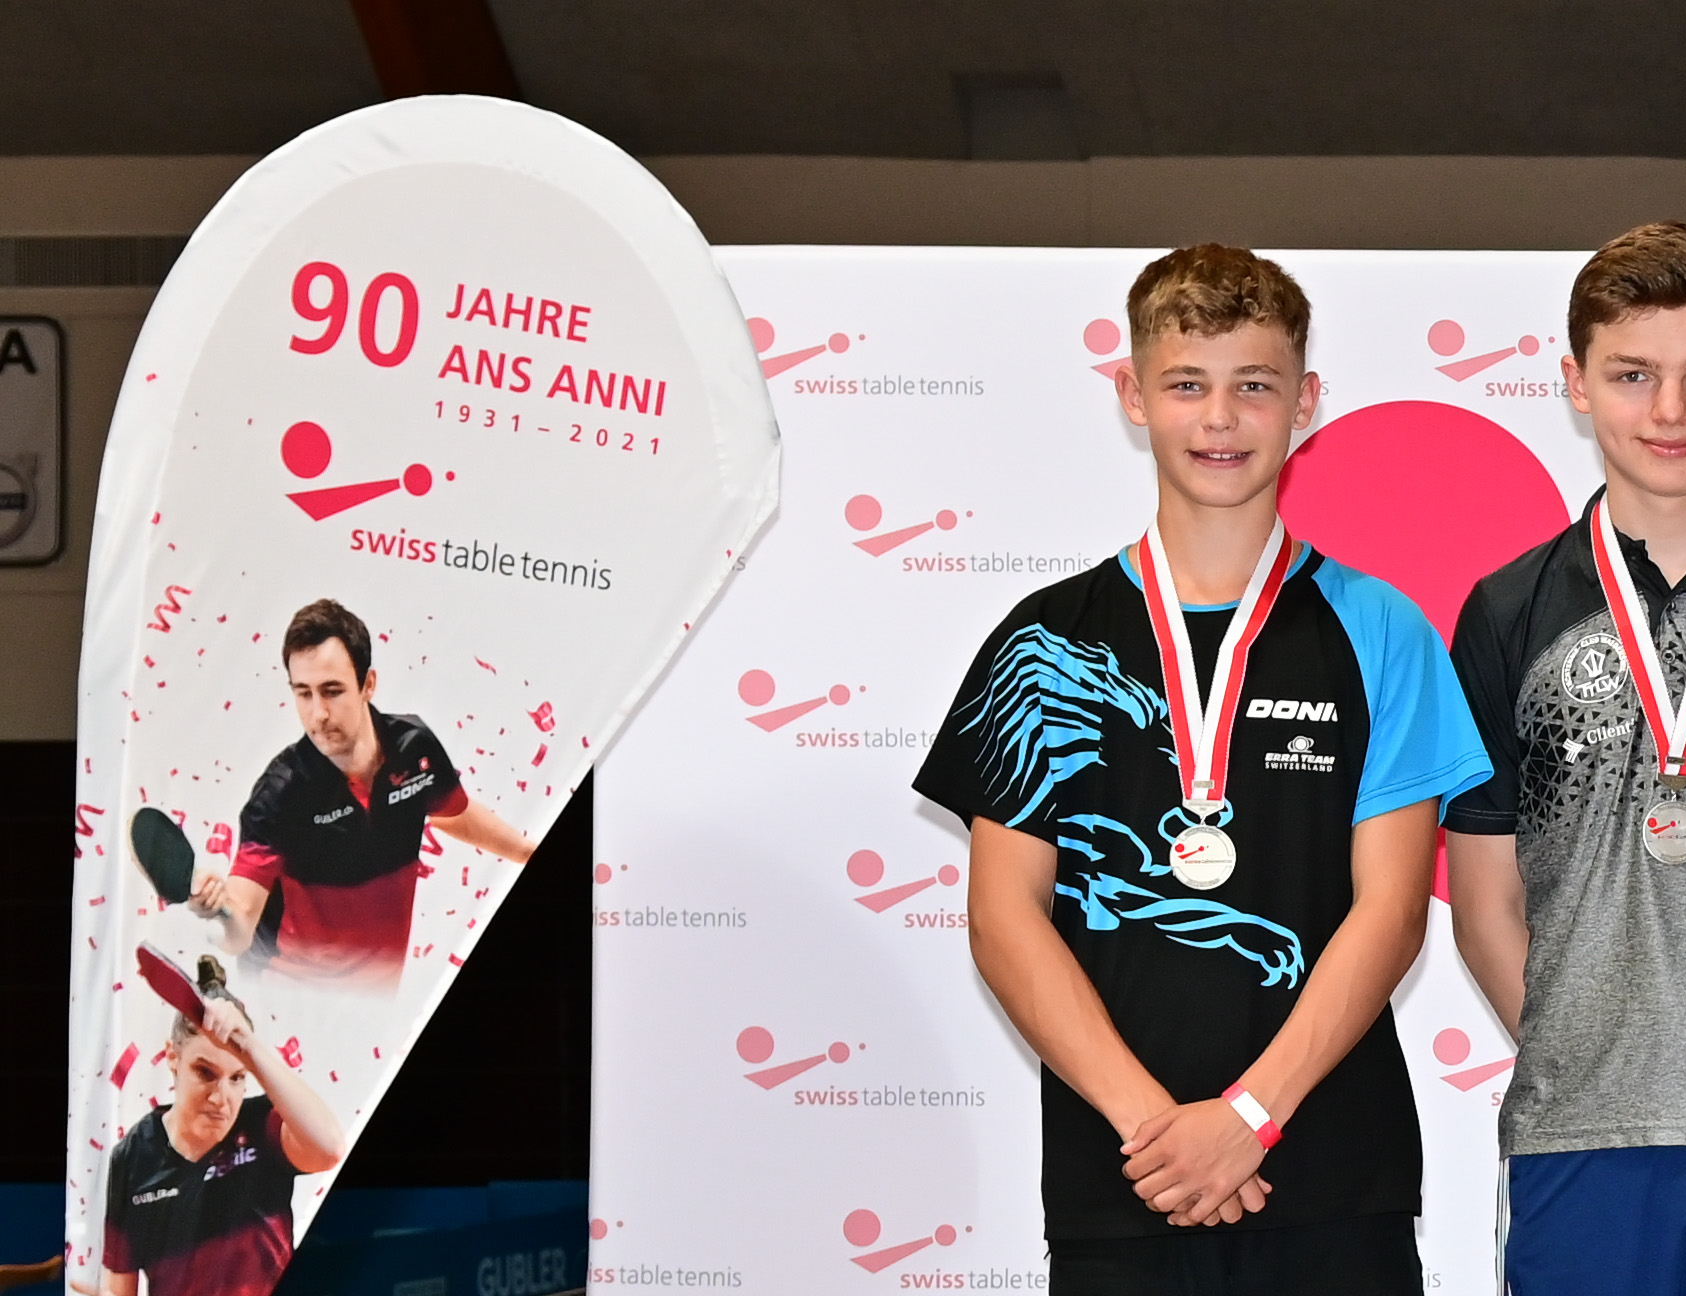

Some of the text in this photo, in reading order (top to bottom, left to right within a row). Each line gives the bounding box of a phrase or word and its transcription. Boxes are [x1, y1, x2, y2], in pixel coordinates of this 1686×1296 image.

[289, 260, 420, 368] 90
[446, 283, 592, 343] JAHRE
[439, 344, 667, 417] ANS ANNI
[350, 527, 612, 591] swiss table tennis
[1300, 754, 1335, 765] TEAM
